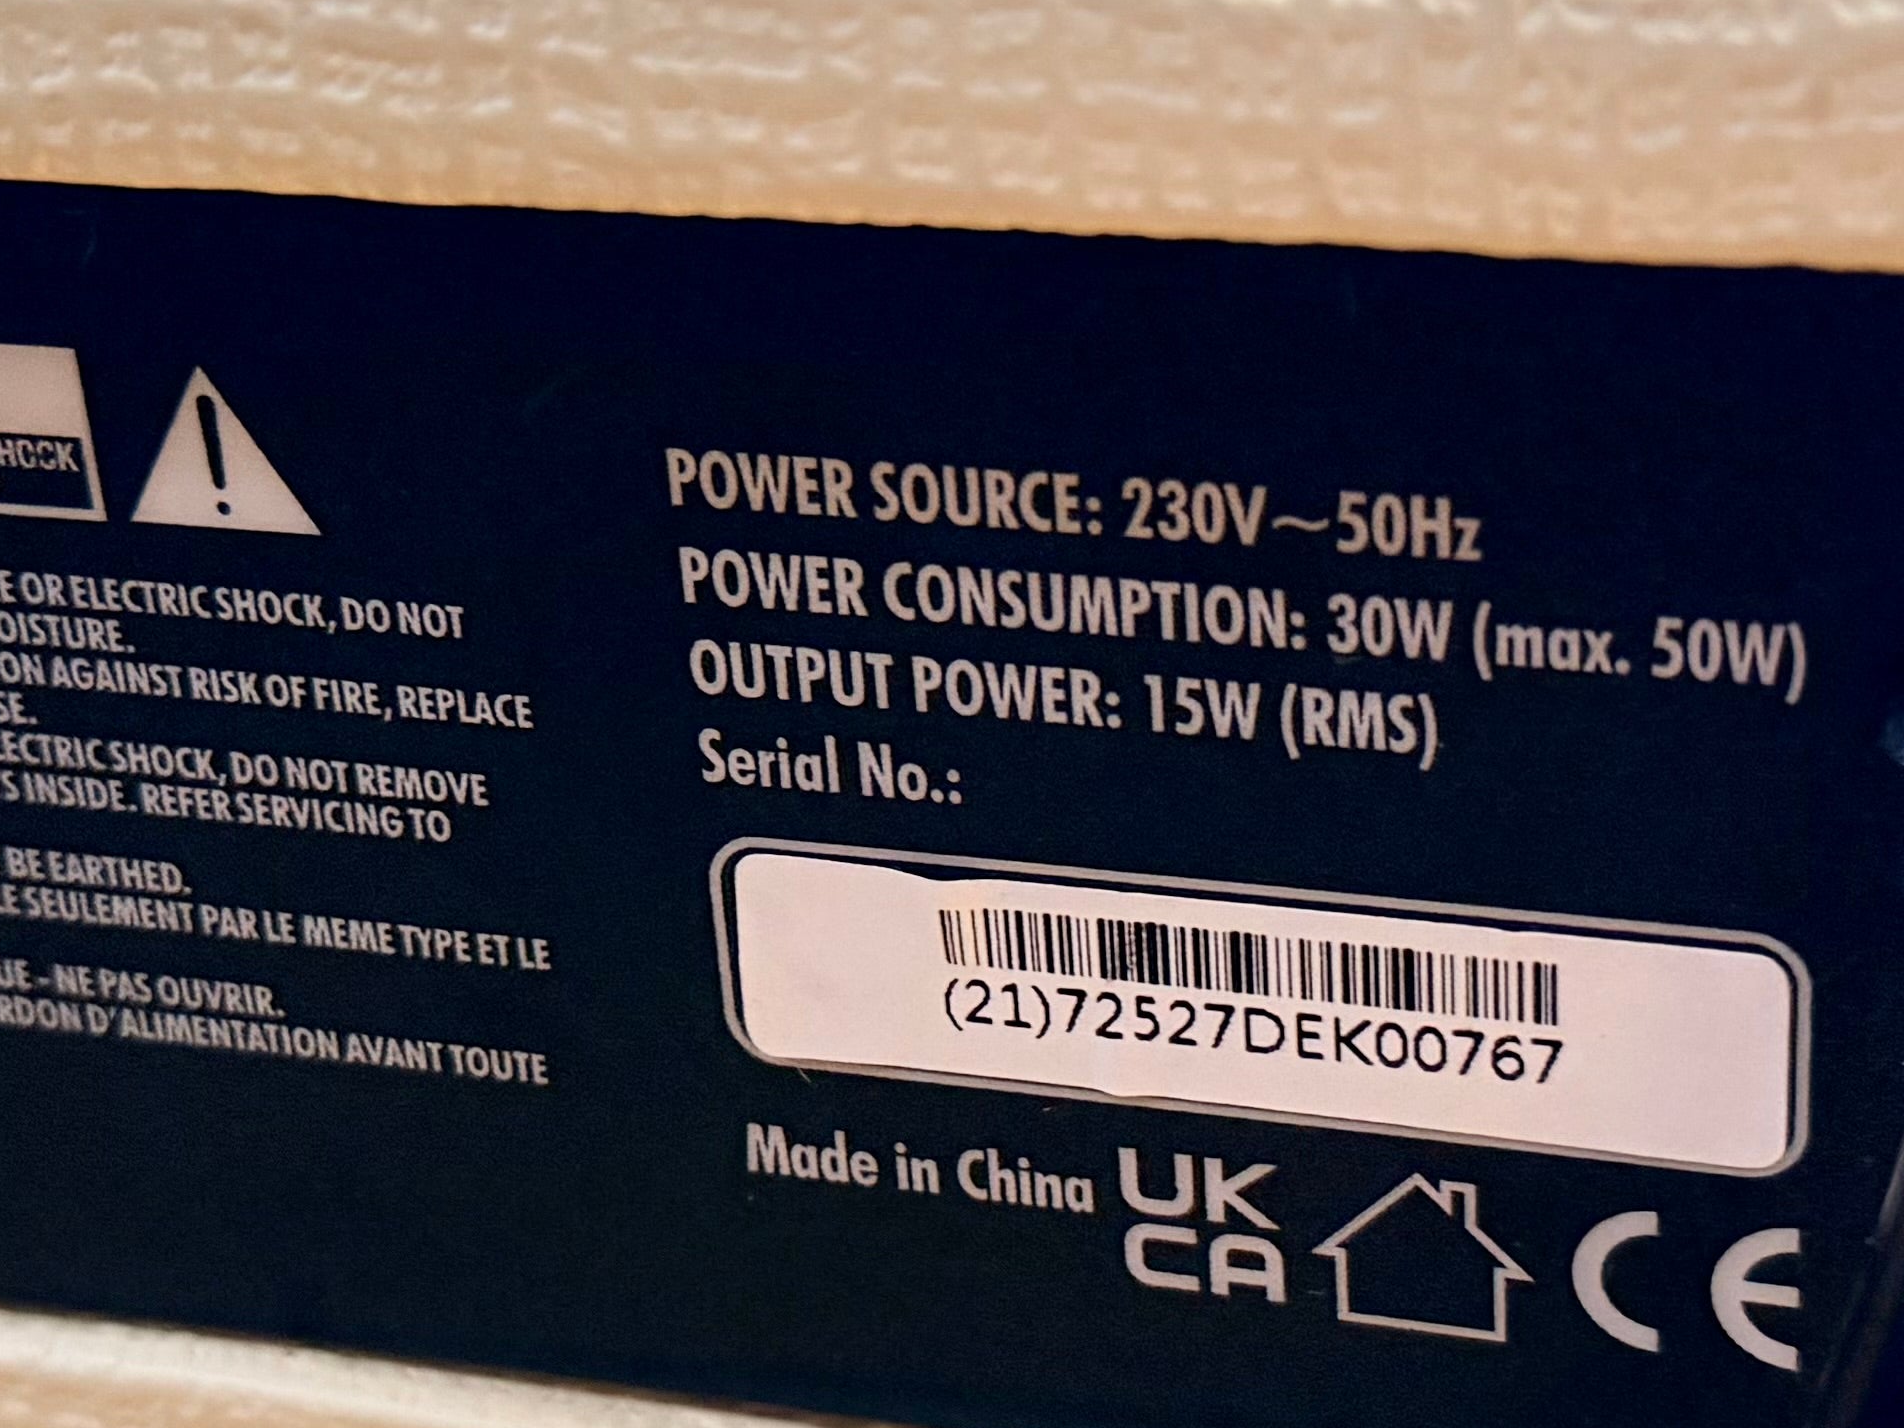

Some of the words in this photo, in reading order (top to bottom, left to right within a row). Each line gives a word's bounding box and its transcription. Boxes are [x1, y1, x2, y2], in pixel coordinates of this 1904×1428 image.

[665, 447, 859, 519] POWER
[869, 461, 1103, 536] SOURCE:
[19, 571, 67, 605] OR
[68, 574, 212, 618] ELECTRIC
[214, 586, 336, 633] SHOCK,
[339, 596, 390, 632] DO
[395, 601, 463, 638] NOT
[678, 546, 870, 617] POWER
[882, 561, 1307, 653] CONSUMPTION:
[1326, 592, 1453, 662] 30W
[1473, 599, 1632, 682] (max.
[1651, 616, 1807, 705] 50W)
[51, 655, 182, 697] AGAINST
[187, 666, 261, 704] RISK
[263, 673, 306, 707] OF
[311, 677, 392, 721] FIRE,
[396, 684, 533, 727] REPLACE
[689, 638, 894, 710] OUTPUT
[911, 655, 1122, 730] POWER:
[1142, 673, 1261, 741] 15W
[1280, 682, 1438, 772] (RMS)
[22, 771, 137, 811] INSIDE.
[139, 782, 233, 821] REFER
[234, 791, 404, 837] SERVICING
[406, 807, 451, 842] TO
[107, 740, 226, 786] SHOCK,
[228, 751, 279, 786] DO
[283, 756, 348, 793] NOT
[354, 762, 488, 806] REMOVE
[698, 727, 842, 794] Serial
[858, 740, 964, 805] No.:
[4, 846, 45, 879] BE
[46, 850, 191, 893] EARTHED.
[22, 886, 193, 931] SEULEMENT
[199, 903, 259, 939] PAR
[262, 910, 296, 943] LE
[302, 914, 395, 953] MEME
[397, 924, 471, 961] TYPE
[475, 932, 509, 965] ET
[516, 936, 551, 969] LE
[53, 963, 95, 996] NE
[97, 967, 152, 1002] PAS
[155, 975, 285, 1017] OUVRIR.
[944, 978, 1564, 1084] (21)72527DEK00767
[85, 1004, 339, 1059] D'ALIMENTATION
[344, 1033, 442, 1072] AVANT
[447, 1044, 548, 1084] TOUTE
[746, 1122, 879, 1188] Made
[895, 1143, 941, 1196] in
[957, 1148, 1095, 1214] China
[1117, 1146, 1282, 1231] UK
[1123, 1222, 1289, 1304] CA
[1571, 1210, 1801, 1372] CE
